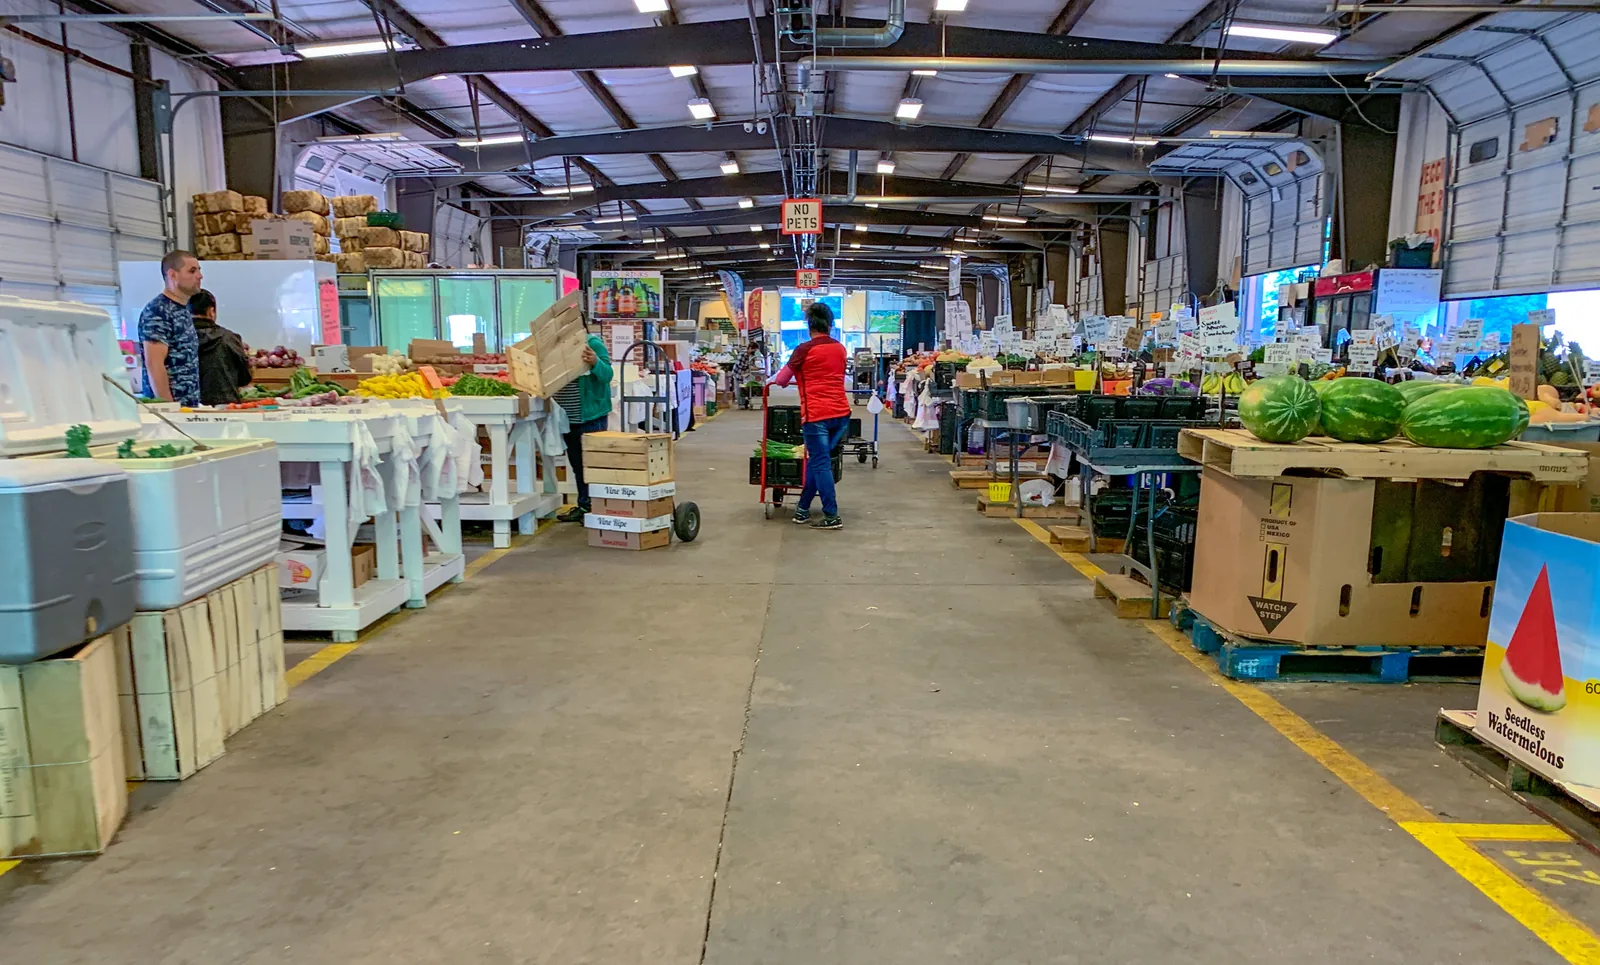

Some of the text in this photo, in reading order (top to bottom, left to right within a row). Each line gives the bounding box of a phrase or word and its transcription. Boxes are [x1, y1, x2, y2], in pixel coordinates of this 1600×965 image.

[794, 204, 809, 215] NO
[786, 217, 818, 229] PETS
[751, 292, 761, 328] MEAT
[604, 486, 637, 498] Vine Ripe
[597, 517, 628, 529] Vine Ripe
[1255, 601, 1288, 612] WATCH
[1259, 611, 1282, 620] STEP
[1504, 706, 1546, 741] Seedless
[1488, 711, 1565, 769] Watermelons
